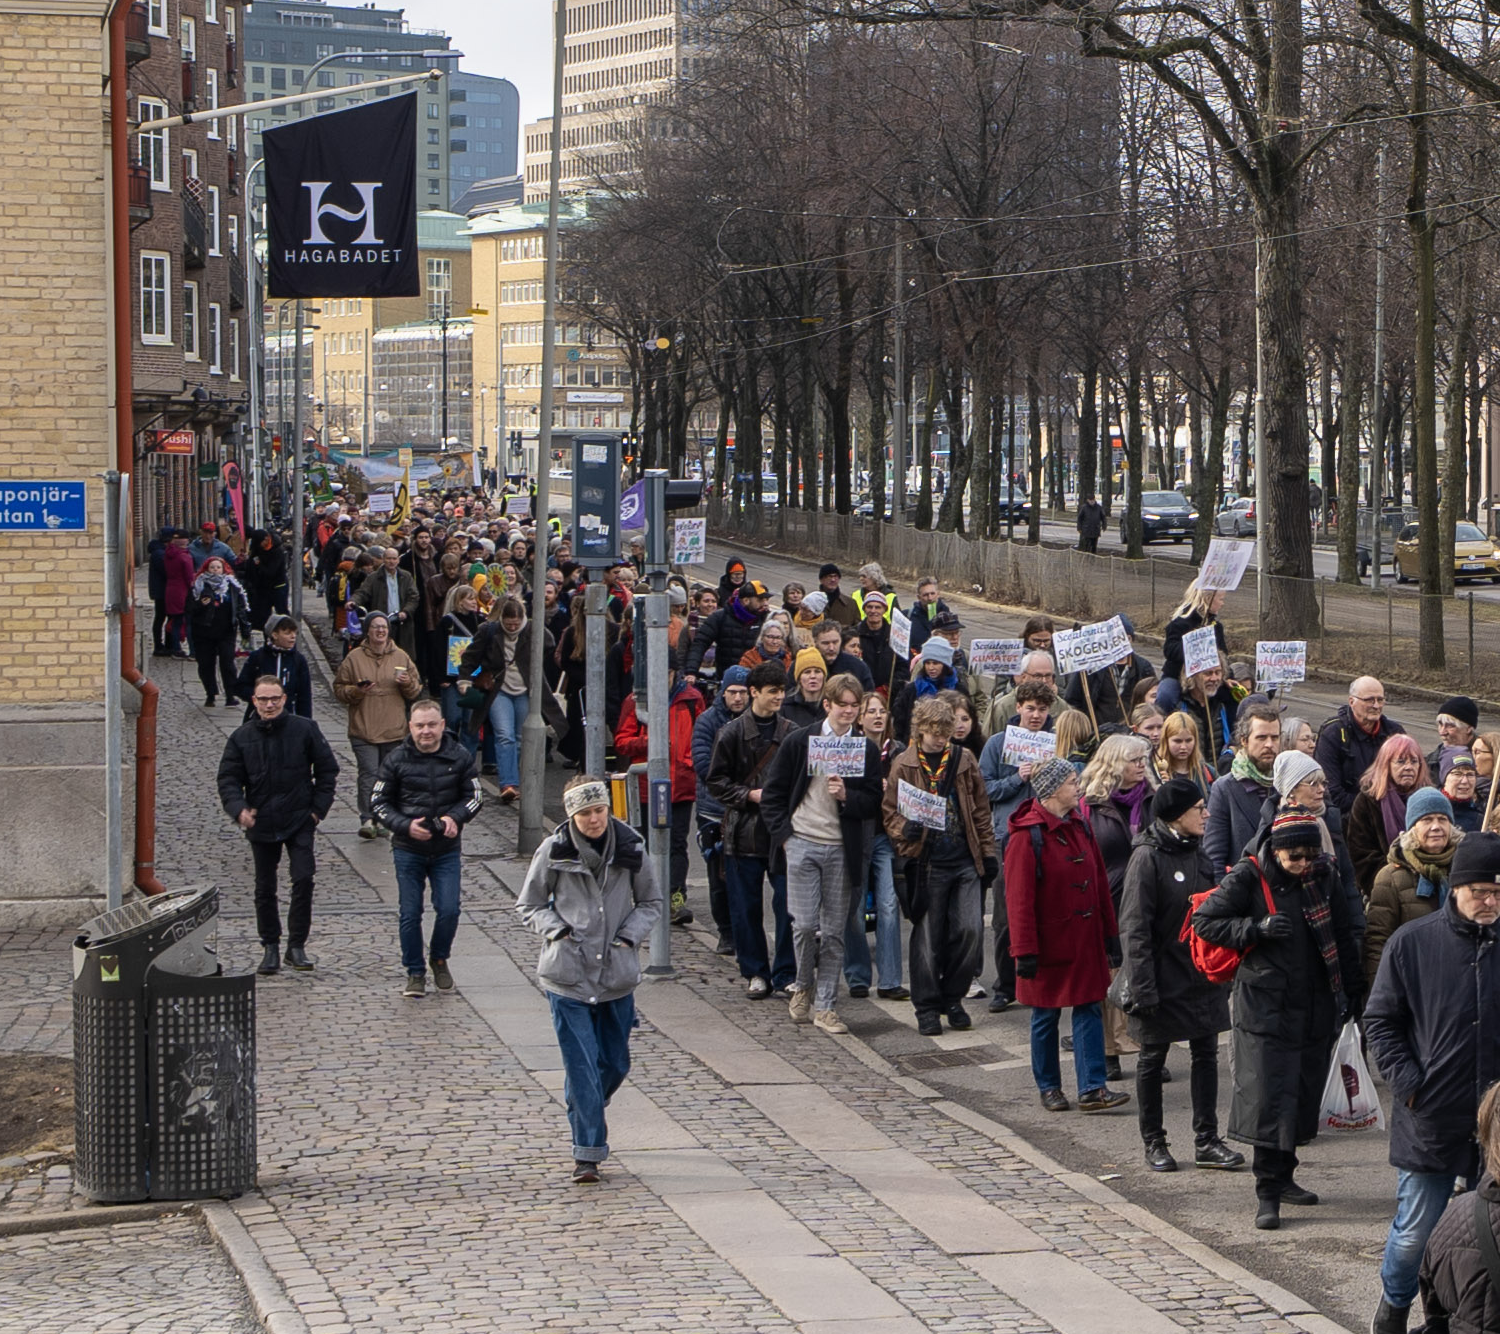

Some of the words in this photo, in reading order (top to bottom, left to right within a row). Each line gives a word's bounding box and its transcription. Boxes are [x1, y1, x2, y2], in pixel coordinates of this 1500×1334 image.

[284, 249, 403, 264] HAGABADET
[1058, 640, 1109, 660] SKOGEN
[972, 654, 1019, 663] KLIMATET
